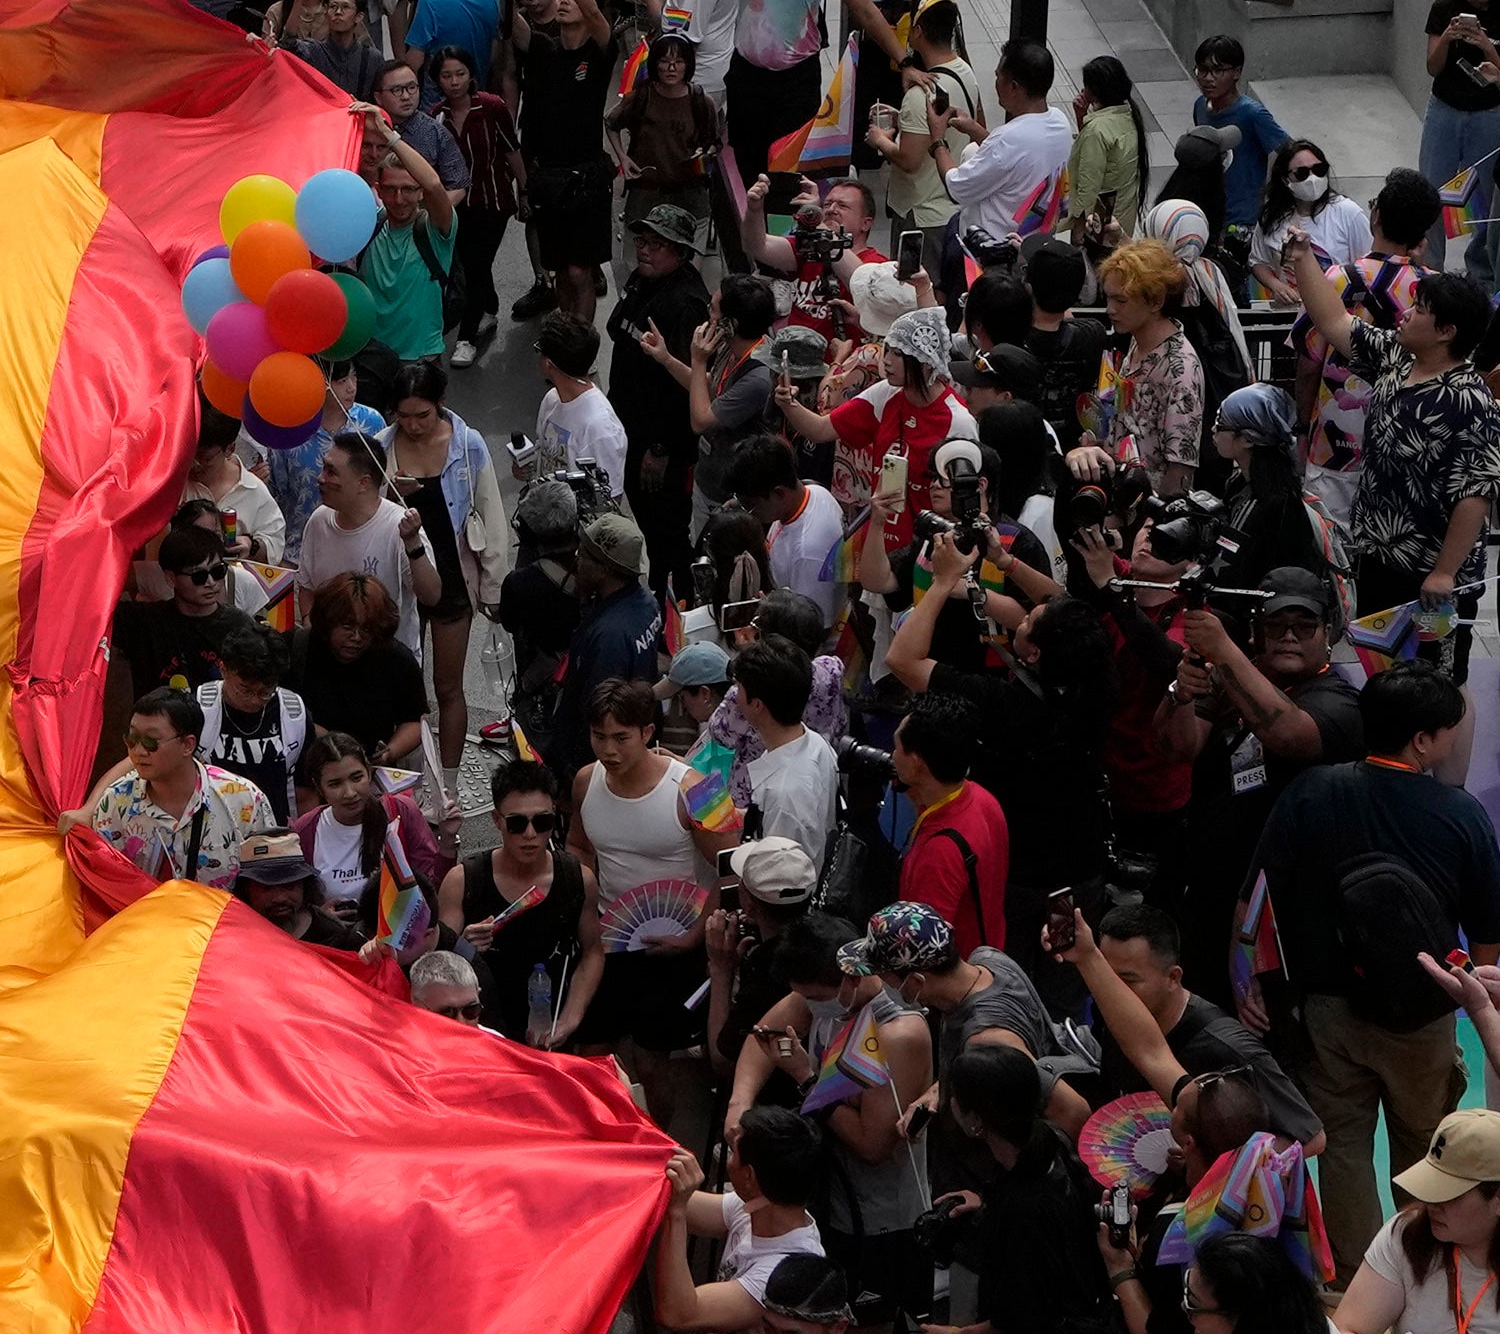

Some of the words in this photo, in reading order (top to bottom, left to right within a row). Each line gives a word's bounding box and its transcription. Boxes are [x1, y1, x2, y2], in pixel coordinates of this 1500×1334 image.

[1335, 438, 1362, 450] BANG
[211, 733, 286, 765] NAVY
[1236, 770, 1265, 786] PRESS
